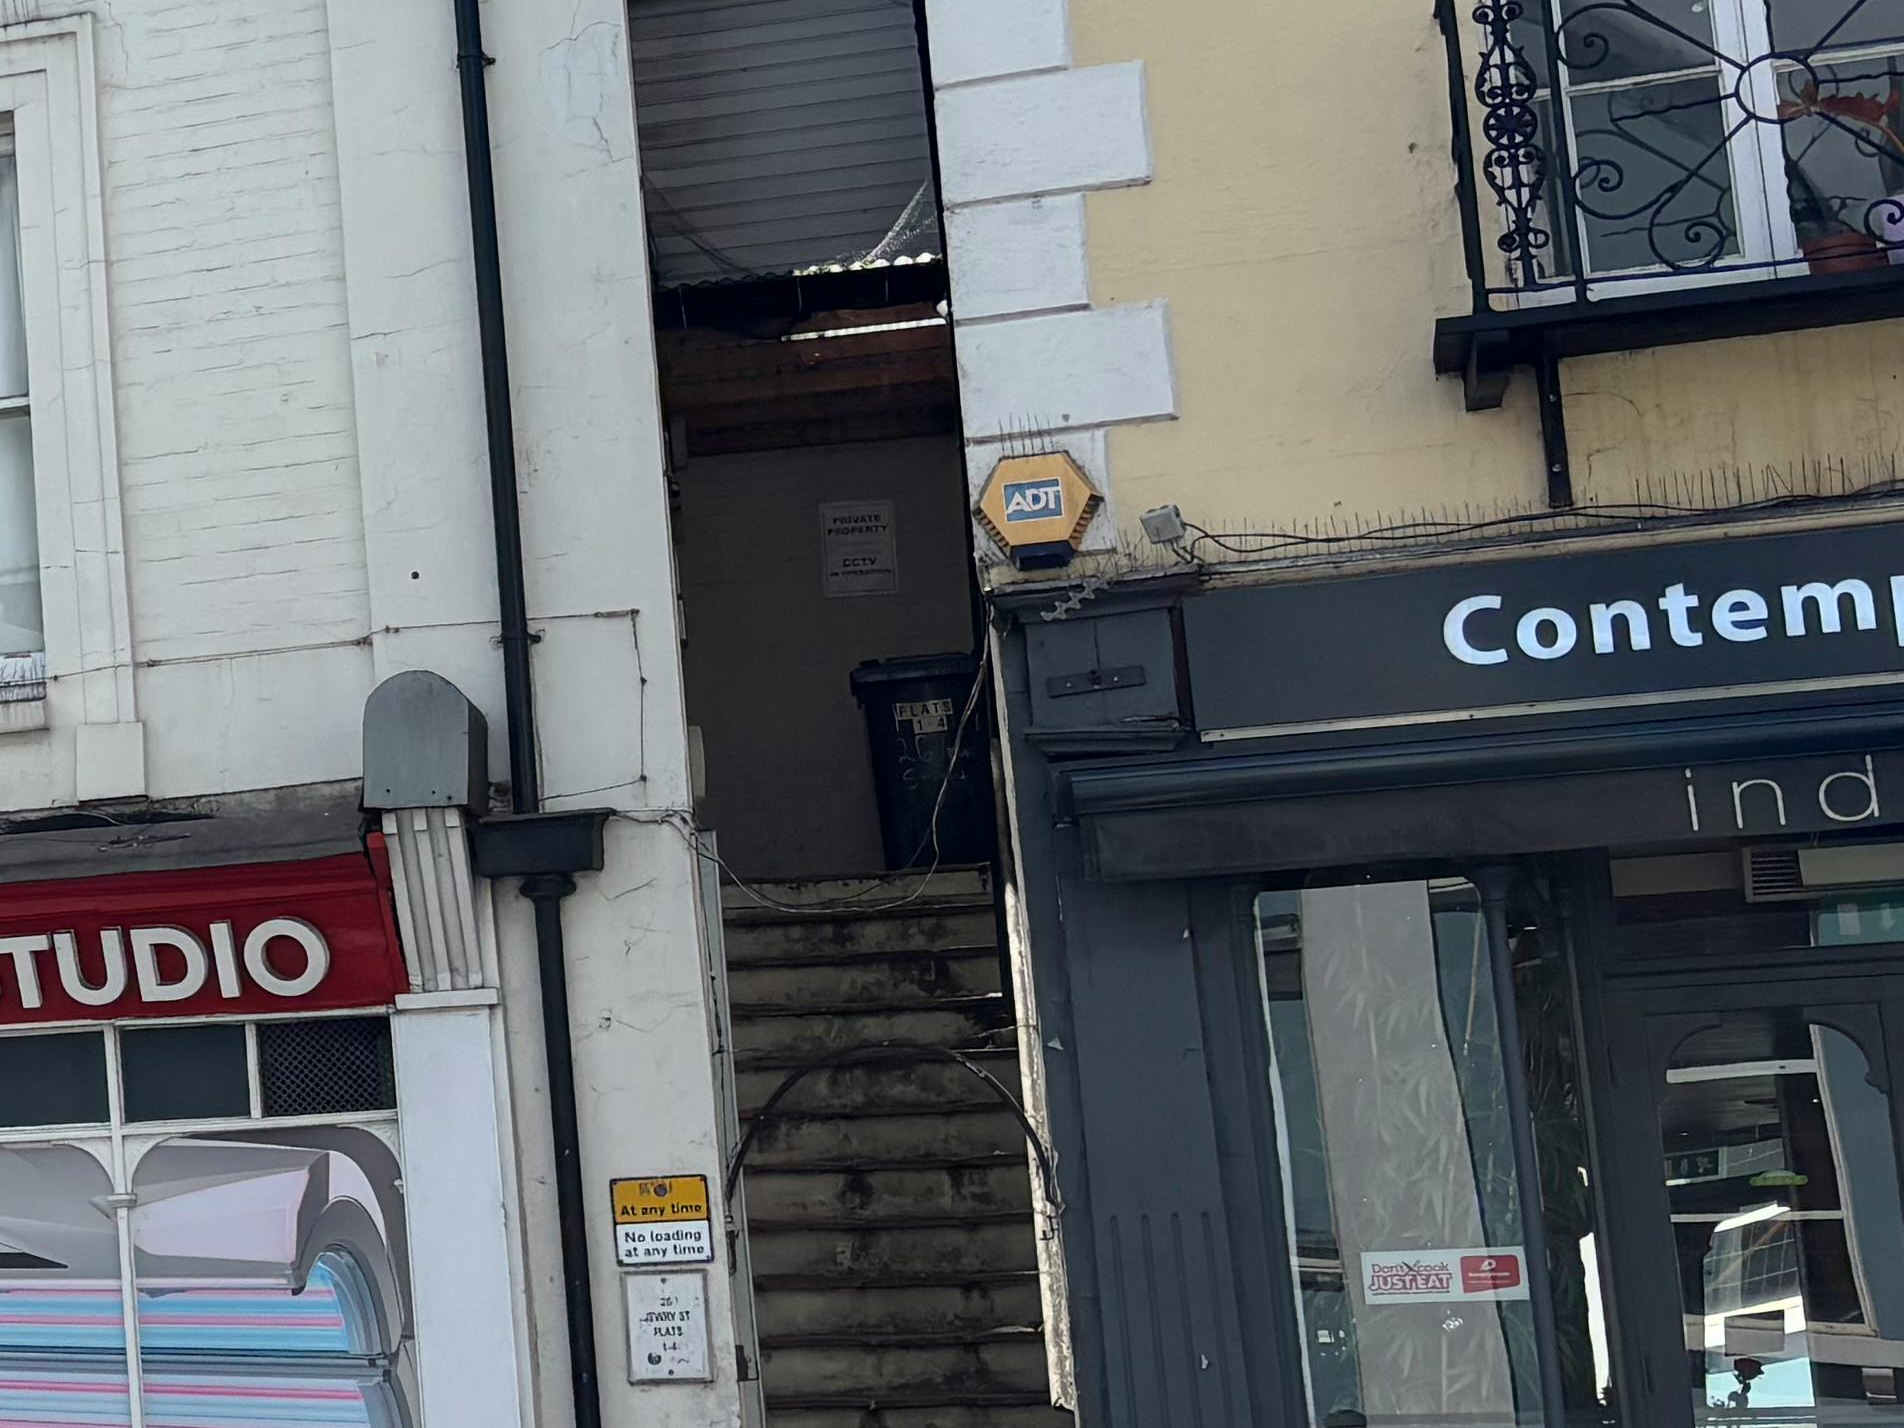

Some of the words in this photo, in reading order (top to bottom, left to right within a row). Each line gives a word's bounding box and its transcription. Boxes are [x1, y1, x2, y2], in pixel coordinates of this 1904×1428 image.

[1006, 485, 1061, 514] ADT
[833, 514, 880, 525] PRIVATE
[827, 524, 888, 536] PROPERTY
[842, 556, 878, 568] CCTV
[1443, 575, 1904, 666] Contem
[899, 700, 951, 718] FLATS
[1684, 754, 1880, 832] ind
[620, 1205, 638, 1217] At
[641, 1206, 666, 1217] any
[671, 1202, 702, 1214] time
[625, 1231, 646, 1244] No
[650, 1229, 702, 1243] loading
[624, 1246, 639, 1259] at
[643, 1246, 668, 1259] any
[672, 1243, 705, 1256] time
[1370, 1274, 1413, 1291] JUST
[1415, 1272, 1452, 1290] EAT
